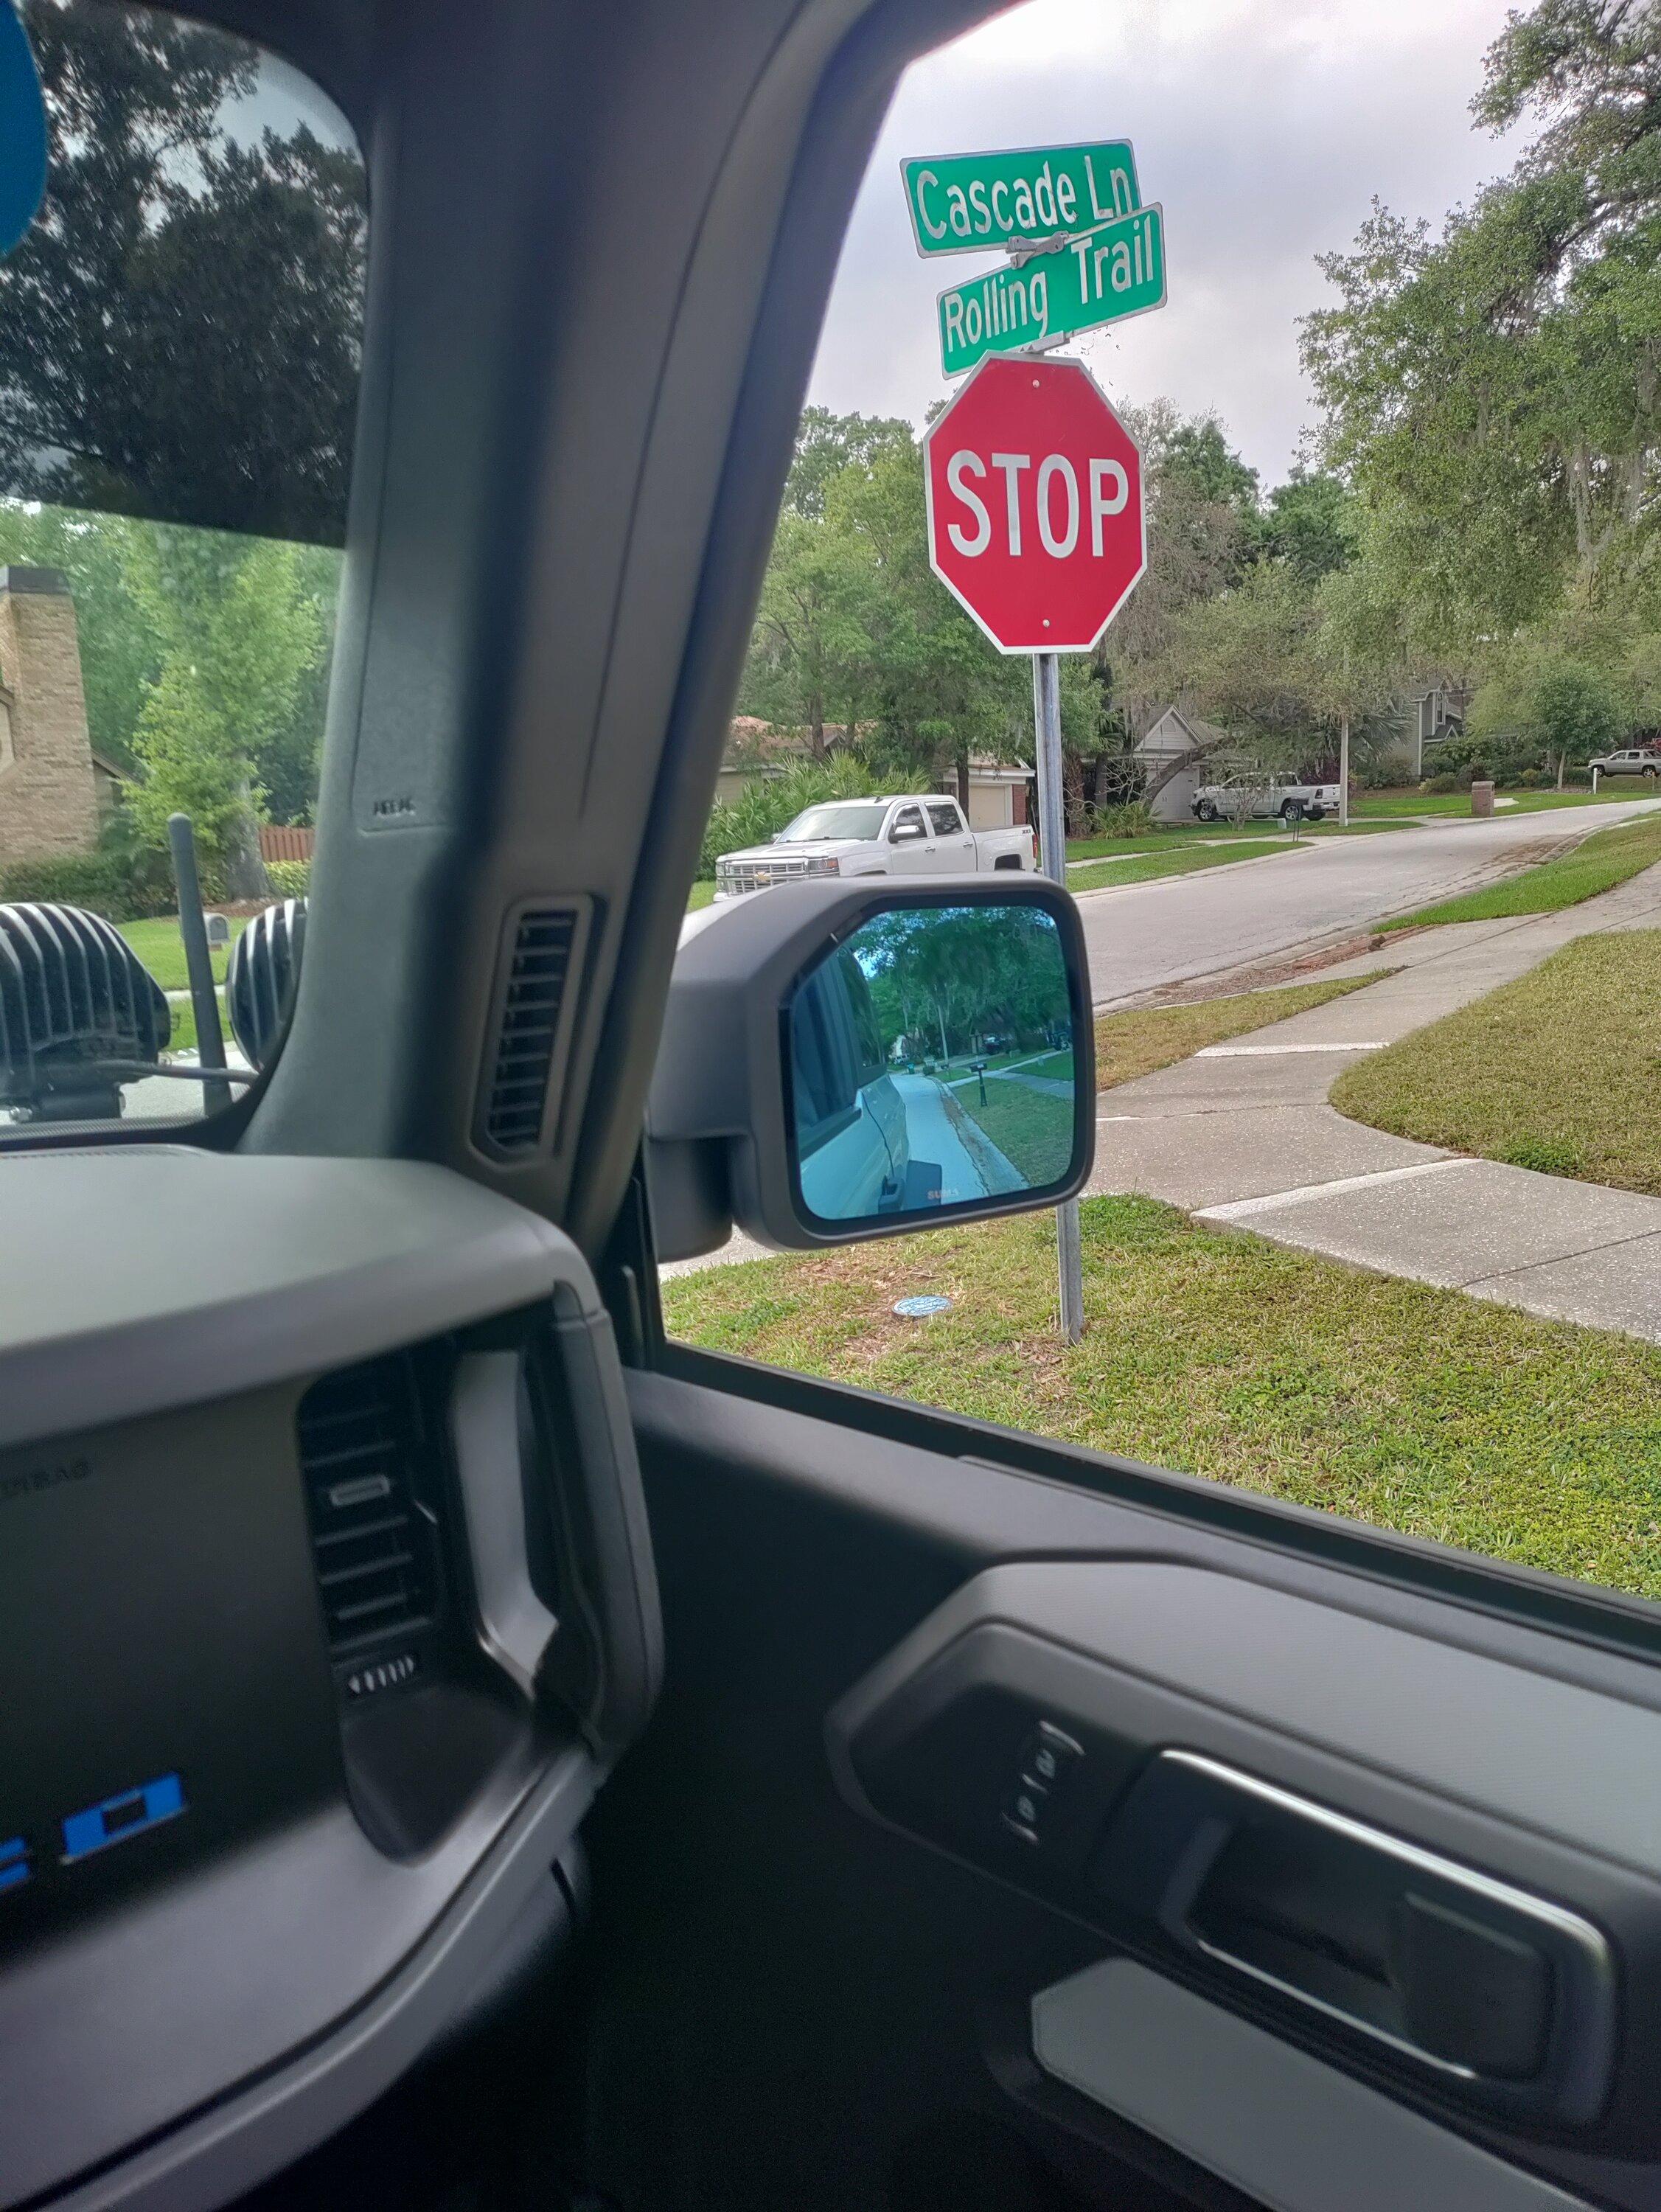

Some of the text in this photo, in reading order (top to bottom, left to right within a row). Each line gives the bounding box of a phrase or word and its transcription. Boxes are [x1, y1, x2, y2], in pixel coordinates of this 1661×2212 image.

[916, 155, 1132, 240] Cascade Ln
[944, 214, 1154, 353] Rolling Trail
[947, 449, 1129, 559] STOP
